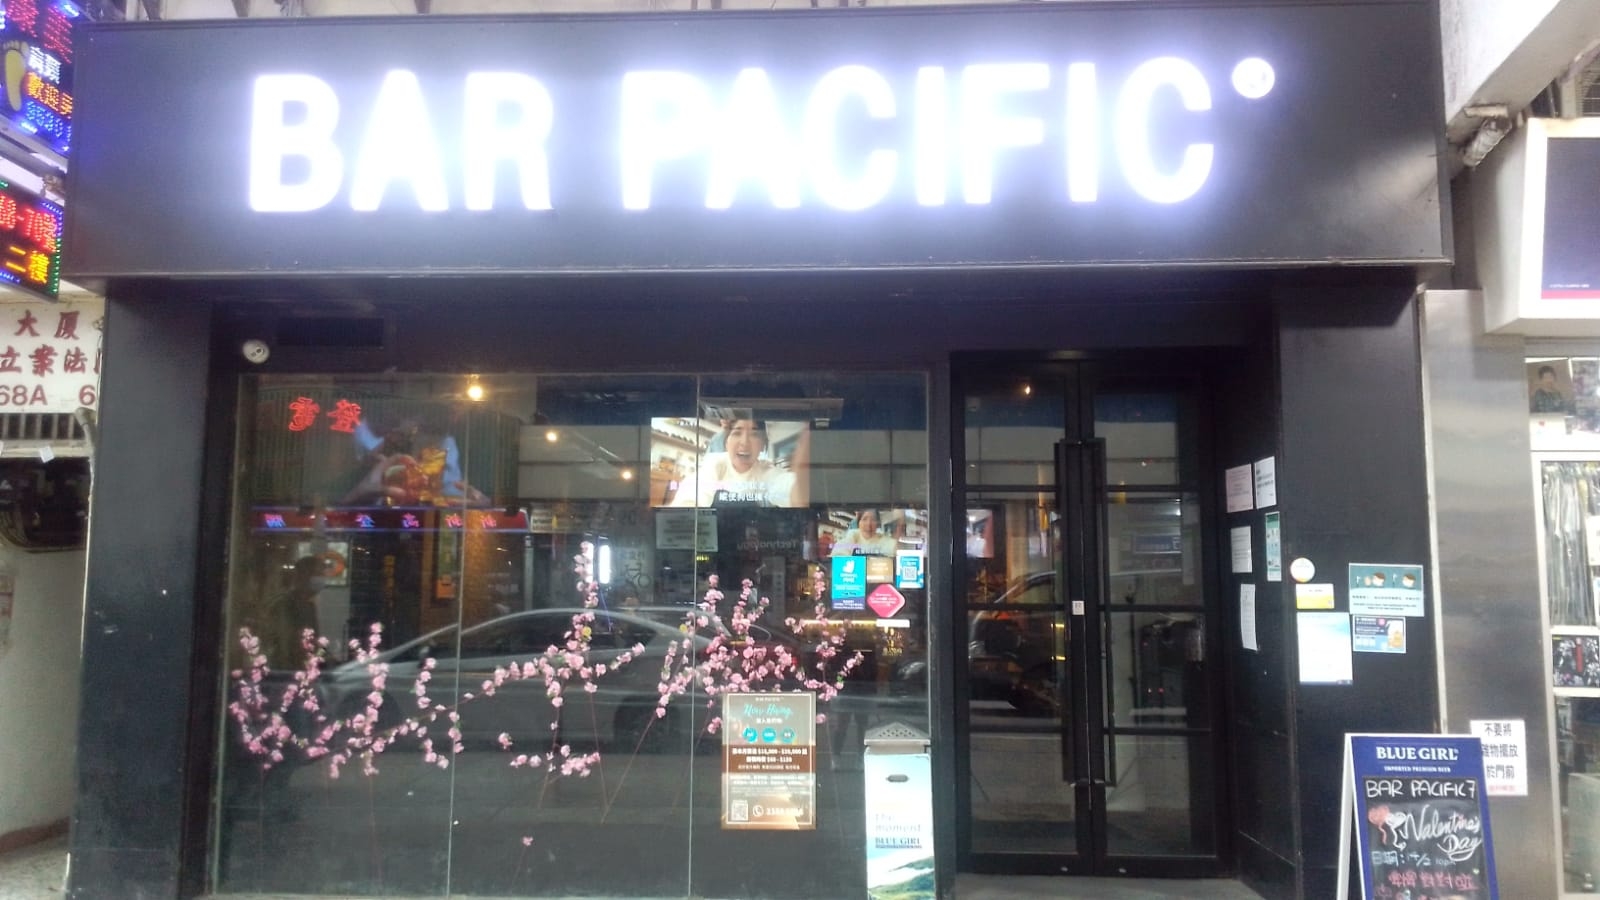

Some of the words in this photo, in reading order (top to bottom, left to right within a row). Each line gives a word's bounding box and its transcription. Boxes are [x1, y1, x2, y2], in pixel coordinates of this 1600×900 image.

[250, 68, 554, 212] BAR
[620, 56, 1214, 209] PACIFIC
[15, 309, 80, 340] 大廈
[0, 344, 102, 377] 立案法
[1484, 722, 1512, 737] 不要將
[1376, 746, 1417, 760] BLUE
[1418, 747, 1458, 761] GIRL
[1486, 764, 1515, 779] 於門前
[1366, 780, 1403, 798] BAR
[1439, 834, 1482, 861] Day
